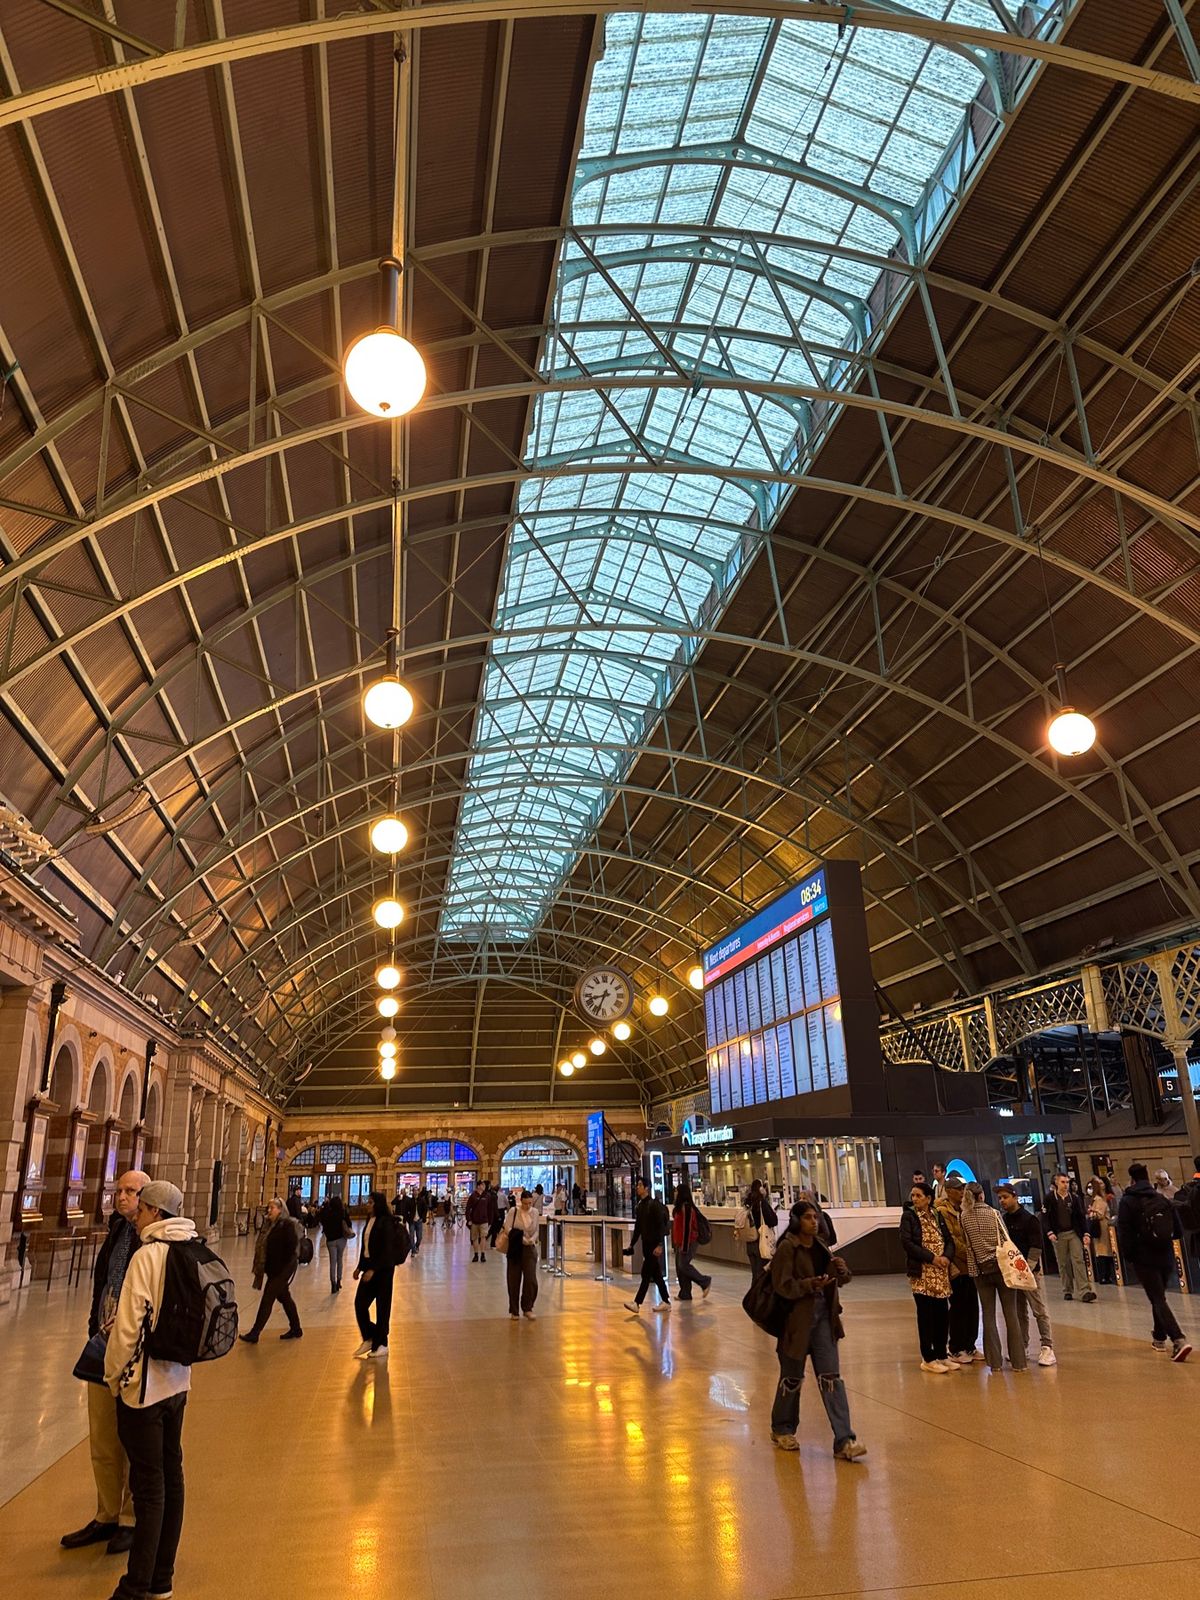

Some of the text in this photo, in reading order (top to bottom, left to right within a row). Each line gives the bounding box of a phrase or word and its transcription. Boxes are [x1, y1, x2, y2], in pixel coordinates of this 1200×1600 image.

[801, 879, 822, 905] 08:34
[709, 952, 719, 967] Next
[719, 937, 741, 961] departures
[1166, 1080, 1174, 1091] 5
[691, 1125, 733, 1147] Transport Information
